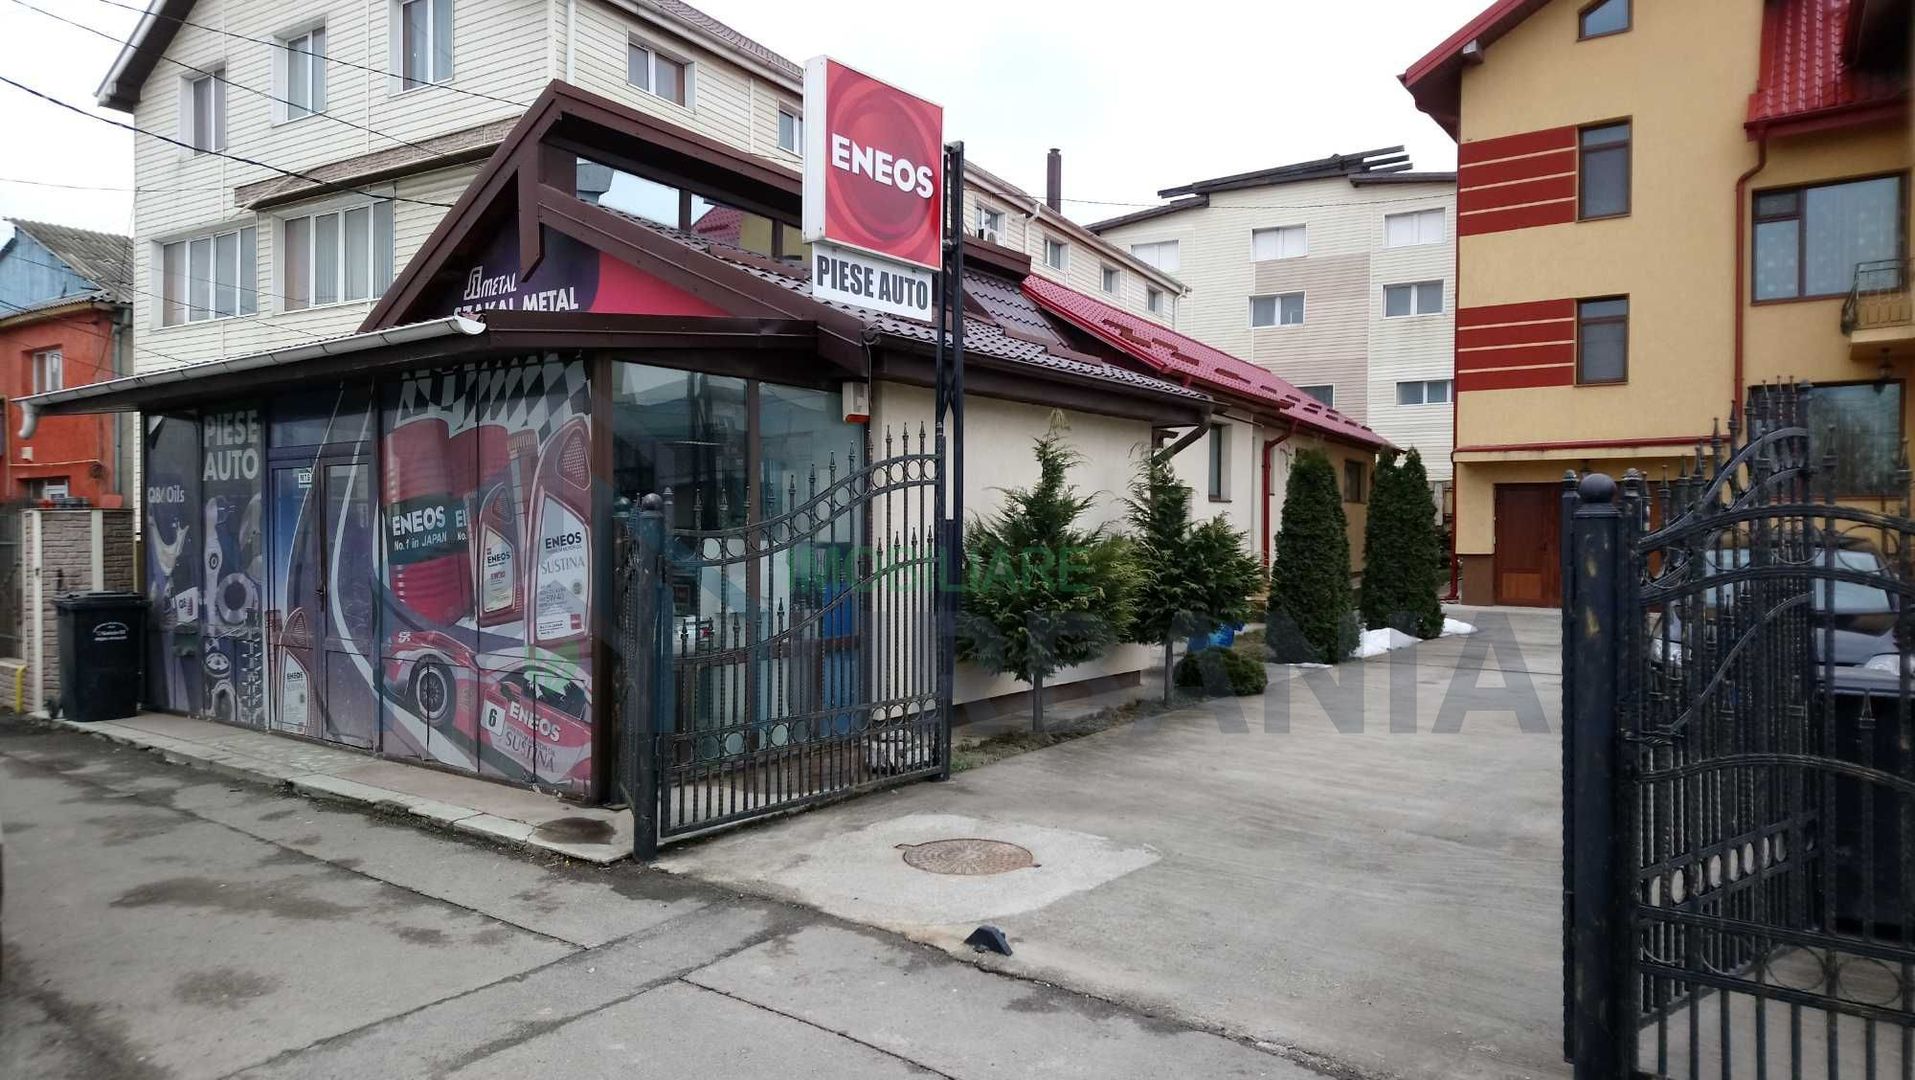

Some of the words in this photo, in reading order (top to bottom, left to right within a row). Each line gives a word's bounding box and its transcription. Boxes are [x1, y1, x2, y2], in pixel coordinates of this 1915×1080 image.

[831, 132, 934, 199] ENEOS
[817, 254, 874, 298] PIESE
[878, 270, 928, 311] AUTO
[523, 287, 579, 311] METAL
[204, 409, 259, 448] PIESE
[203, 448, 260, 482] AUTO
[167, 484, 185, 503] Oils
[392, 505, 446, 536] ENEOS
[421, 531, 447, 547] JAPAN
[545, 531, 582, 549] ENEOS
[487, 551, 511, 564] ENEOS
[541, 556, 585, 575] SUSTINA
[488, 708, 498, 728] 6
[509, 701, 561, 742] ENEOS
